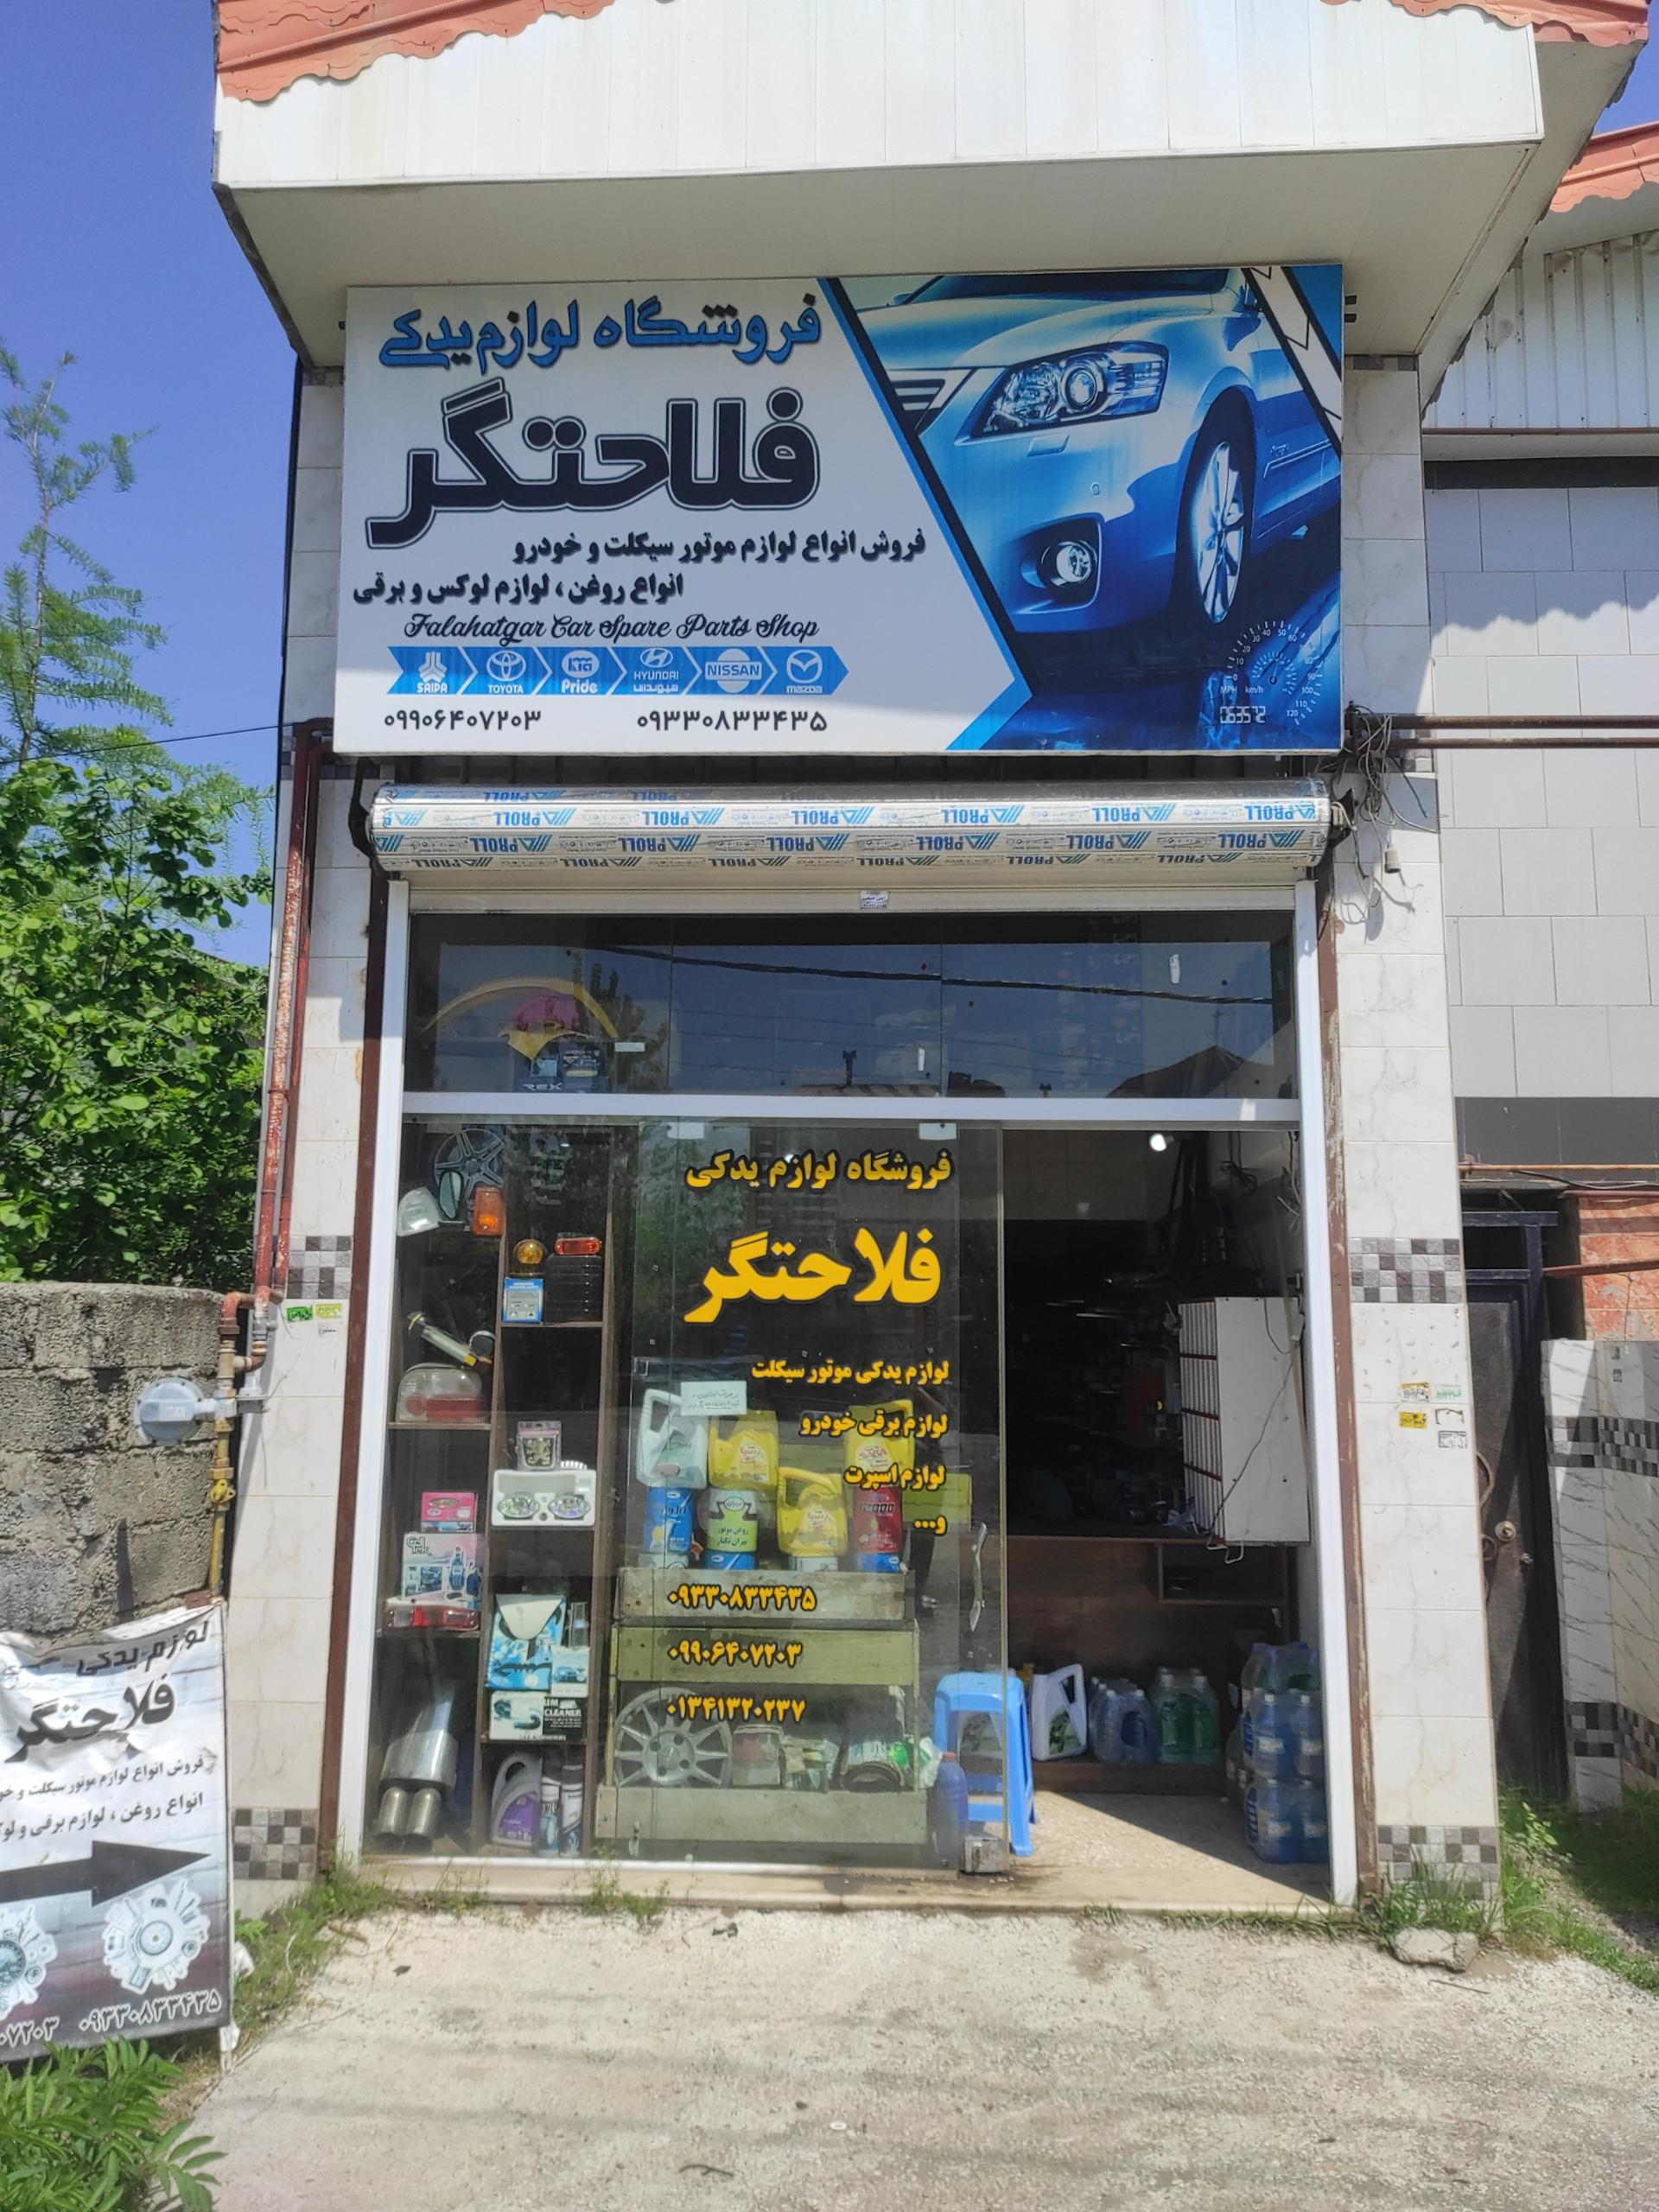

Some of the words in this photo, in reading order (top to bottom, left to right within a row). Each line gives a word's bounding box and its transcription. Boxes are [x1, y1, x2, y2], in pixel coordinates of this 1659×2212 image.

[378, 308, 474, 371] یدکی
[476, 299, 580, 375] لوازم
[593, 293, 822, 365] فروشگاه
[365, 377, 819, 550] فلاحتگر
[512, 532, 582, 564] خودرو
[586, 541, 600, 564] و
[604, 531, 675, 562] سیکلت
[678, 531, 736, 563] موتور
[741, 530, 797, 563] لوازم
[801, 530, 856, 563] انواع
[861, 527, 926, 562] فروش
[353, 572, 406, 605] برقی
[409, 582, 423, 605] و
[427, 573, 491, 605] لوکس
[495, 573, 550, 605] لوازم
[568, 574, 626, 605] روغن
[630, 572, 684, 605] انواع
[404, 613, 548, 647] Falahatgar
[550, 613, 595, 639] Car
[599, 613, 672, 644] Spare
[676, 613, 753, 639] Parts
[755, 613, 821, 644] Shop
[633, 671, 679, 681] HYUNDAI
[707, 664, 760, 677] NISSAN
[416, 682, 448, 694] SAIPA
[487, 683, 524, 694] TOYOTA
[562, 679, 599, 694] Pride
[786, 685, 823, 694] mazda
[385, 709, 541, 730] ۰۹۹۰۶۴۰۷۲۰۳
[637, 710, 828, 731] ۰۹۳۳۰۸۳۳۴۳۵
[493, 810, 540, 827] PROLL
[641, 810, 690, 826] PROLL
[791, 810, 839, 825] PROLL
[940, 808, 989, 823] PROLL
[1091, 806, 1141, 822] PROLL
[1243, 804, 1294, 820] PROLL
[469, 837, 518, 853] PROLL
[617, 837, 666, 853] PROLL
[766, 836, 815, 852] PROLL
[916, 836, 963, 851] PROLL
[1065, 835, 1115, 849] PROLL
[1217, 833, 1267, 849] PROLL
[686, 1150, 759, 1189] یدکی
[769, 1150, 837, 1190] لوازم
[846, 1148, 952, 1191] فروشگاه
[683, 1227, 942, 1324] فلاحتگر
[750, 1359, 805, 1382] سیکلت
[806, 1357, 852, 1384] موتور
[855, 1360, 902, 1385] یدکی
[906, 1357, 950, 1386] لوازم
[799, 1409, 856, 1437] خودرو
[858, 1408, 902, 1439] برقی
[903, 1414, 949, 1439] لوازم
[844, 1464, 898, 1489] اسپرت
[899, 1465, 946, 1490] لوازم
[668, 1583, 817, 1611] ۰۹۳۳۰۸۳۳۴۳۵
[76, 1647, 141, 1676] یدکی
[668, 1638, 804, 1669] ۰۹۹۰۶۴۰۷۲۰۳
[4, 1673, 176, 1764] فلاحتگر
[665, 1694, 807, 1724] ۰۱۳۴۱۳۲۰۲۳۷
[99, 1767, 129, 1789] لوازم
[131, 1761, 164, 1782] انواع
[167, 1755, 204, 1777] فروش
[17, 1789, 24, 1801] و
[28, 1780, 67, 1797] سیکلت
[68, 1776, 97, 1796] موتور
[120, 1801, 162, 1823] روغن
[166, 1792, 204, 1816] انواع
[29, 1815, 65, 1838] برقی
[68, 1807, 105, 1831] لوازم
[19, 1824, 27, 1840] و
[79, 1989, 222, 2032] ۰۹۳۳۰۸۳۳۴۳۵
